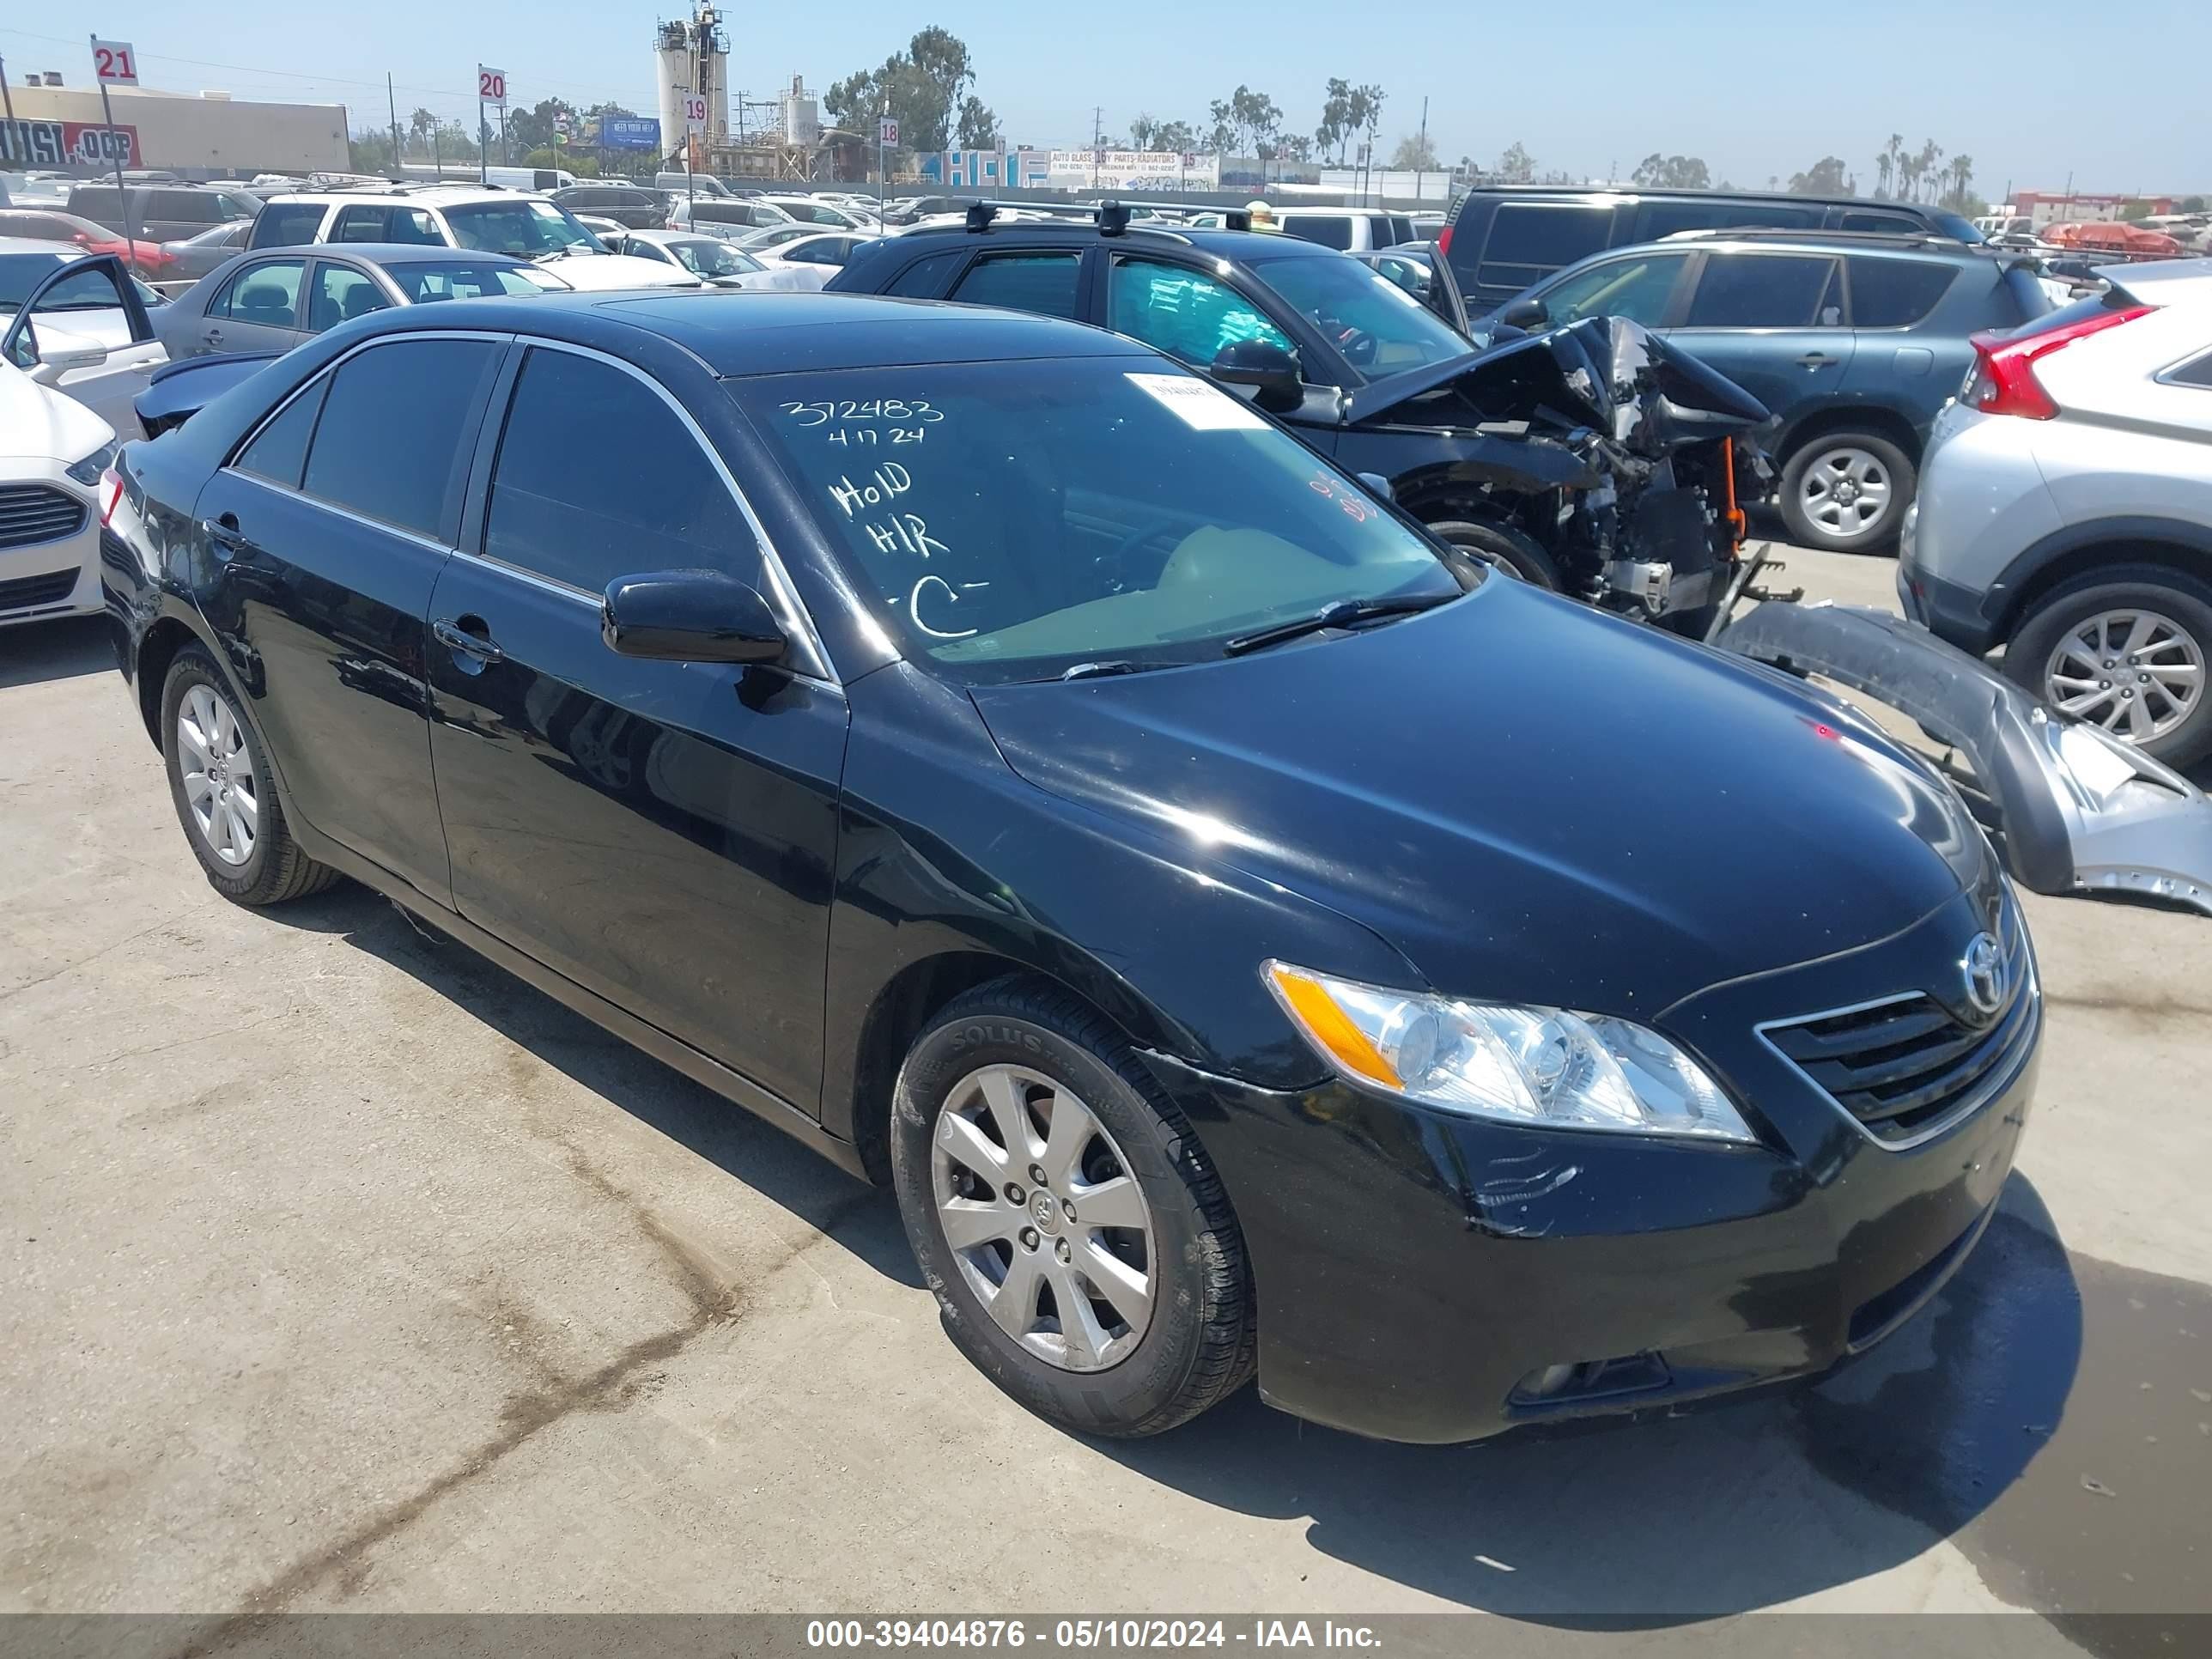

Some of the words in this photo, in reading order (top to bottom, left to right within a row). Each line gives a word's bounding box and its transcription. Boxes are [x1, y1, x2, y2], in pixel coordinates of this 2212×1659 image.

[95, 48, 136, 78] 21
[480, 73, 504, 99] 20
[687, 100, 705, 120] 19
[882, 124, 897, 142] 18
[1052, 153, 1070, 162] AUTO
[1095, 149, 1107, 163] 16
[1182, 154, 1195, 167] 15
[779, 400, 945, 426] 372483
[889, 428, 924, 443] 24
[953, 1025, 1042, 1053] SOLUS
